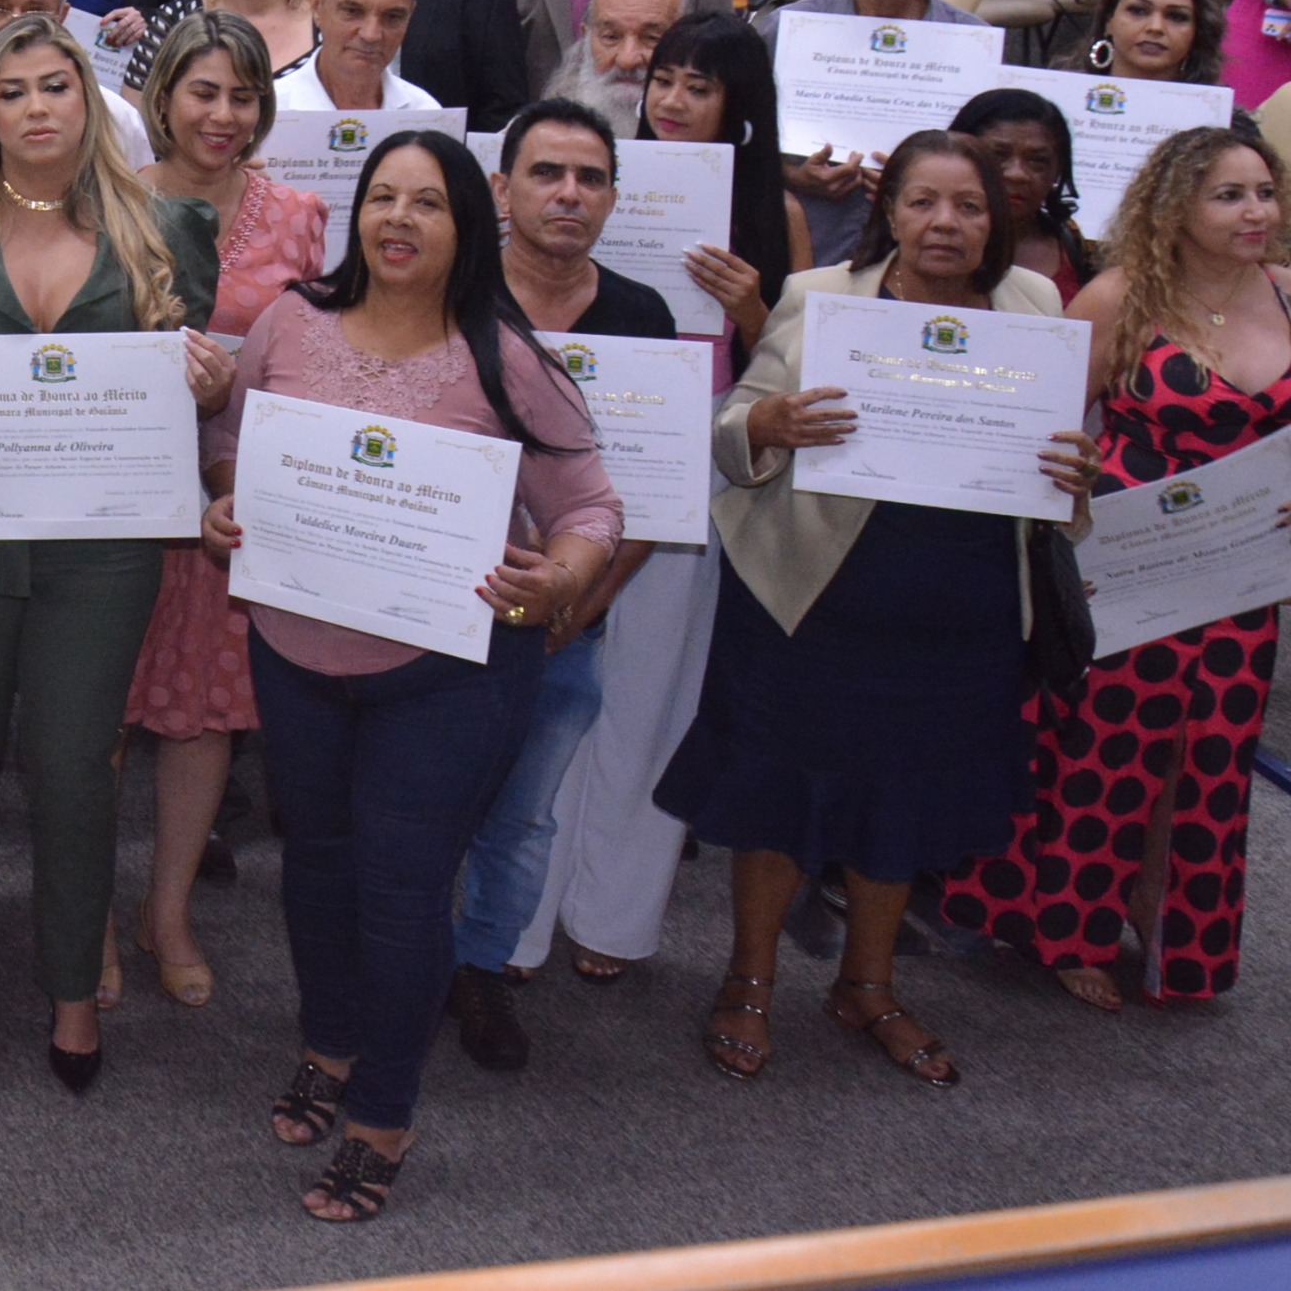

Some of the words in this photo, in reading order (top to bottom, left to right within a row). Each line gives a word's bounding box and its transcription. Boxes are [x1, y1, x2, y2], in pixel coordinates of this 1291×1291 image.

[21, 391, 34, 401] de
[39, 390, 79, 402] Honra
[84, 393, 98, 401] ao
[103, 389, 147, 401] Mérito
[24, 407, 72, 417] Municipal
[89, 406, 127, 415] Goiânia
[861, 403, 909, 417] Marilene
[912, 409, 952, 421] Pereira
[955, 414, 974, 424] dos
[978, 416, 1015, 428] Santos
[54, 442, 67, 451] de
[70, 442, 114, 451] Oliveira
[611, 442, 643, 453] Paula
[281, 454, 332, 476] Diploma
[336, 467, 349, 479] de
[354, 469, 393, 489] Honra
[397, 483, 411, 493] ao
[415, 485, 461, 503] Mérito
[297, 476, 333, 492] Câmara
[336, 485, 383, 503] Municipal
[386, 496, 396, 506] de
[399, 499, 437, 515] Goiânia
[295, 513, 340, 532] Valdelice
[343, 525, 386, 543] Moreira
[389, 535, 427, 552] Duarte
